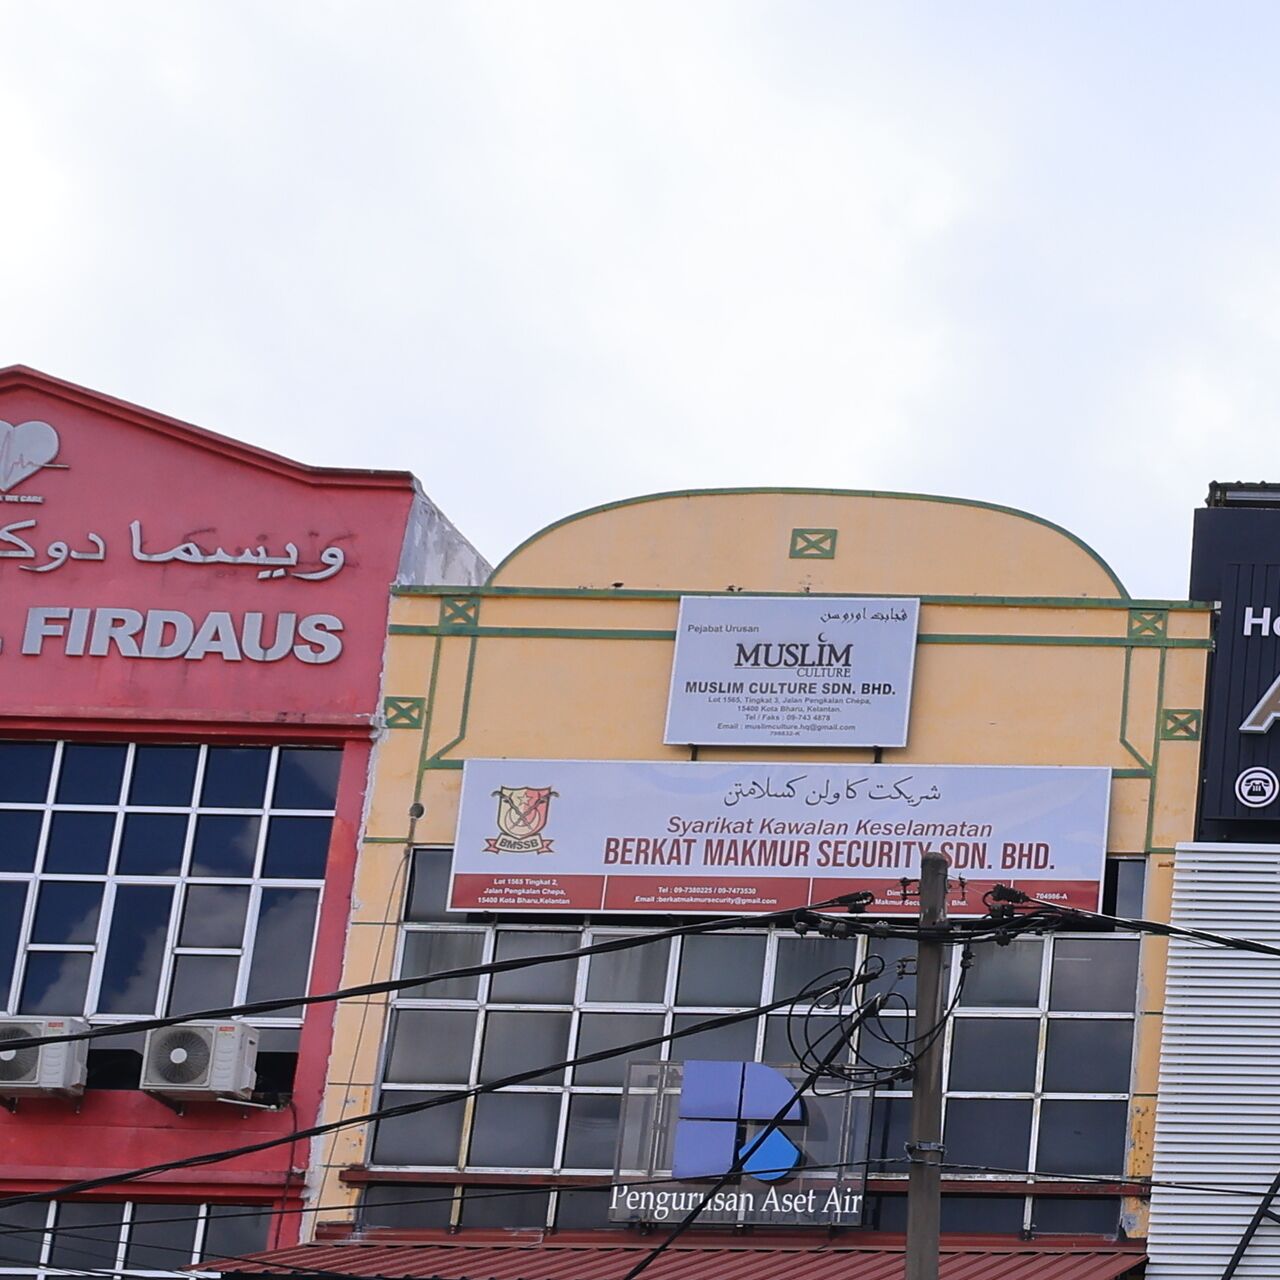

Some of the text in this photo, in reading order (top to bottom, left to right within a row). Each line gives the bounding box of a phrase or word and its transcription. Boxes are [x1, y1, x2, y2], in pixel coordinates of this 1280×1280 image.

[22, 606, 344, 665] FIRDAUS
[687, 624, 760, 635] Pejabat Urusan
[796, 667, 851, 678] CULTURE
[685, 681, 896, 696] MUSLIM CULTURE SDN. BHD.
[745, 696, 773, 705] Tingkat
[783, 696, 803, 704] Jalan
[805, 697, 844, 706] Pengkalan
[666, 816, 993, 838] Syarikat Kawalan Keselamatan
[499, 837, 539, 850] BMSSB
[603, 837, 696, 866] BERKAT
[702, 838, 811, 868] MAKMUR
[940, 841, 992, 869] SDN.
[1001, 842, 1055, 870] BHD.
[525, 878, 551, 886] Tingkat
[504, 888, 541, 896] Pengkalan
[635, 895, 655, 903] Email
[760, 1185, 816, 1214] Aset
[817, 1186, 864, 1214] Air
